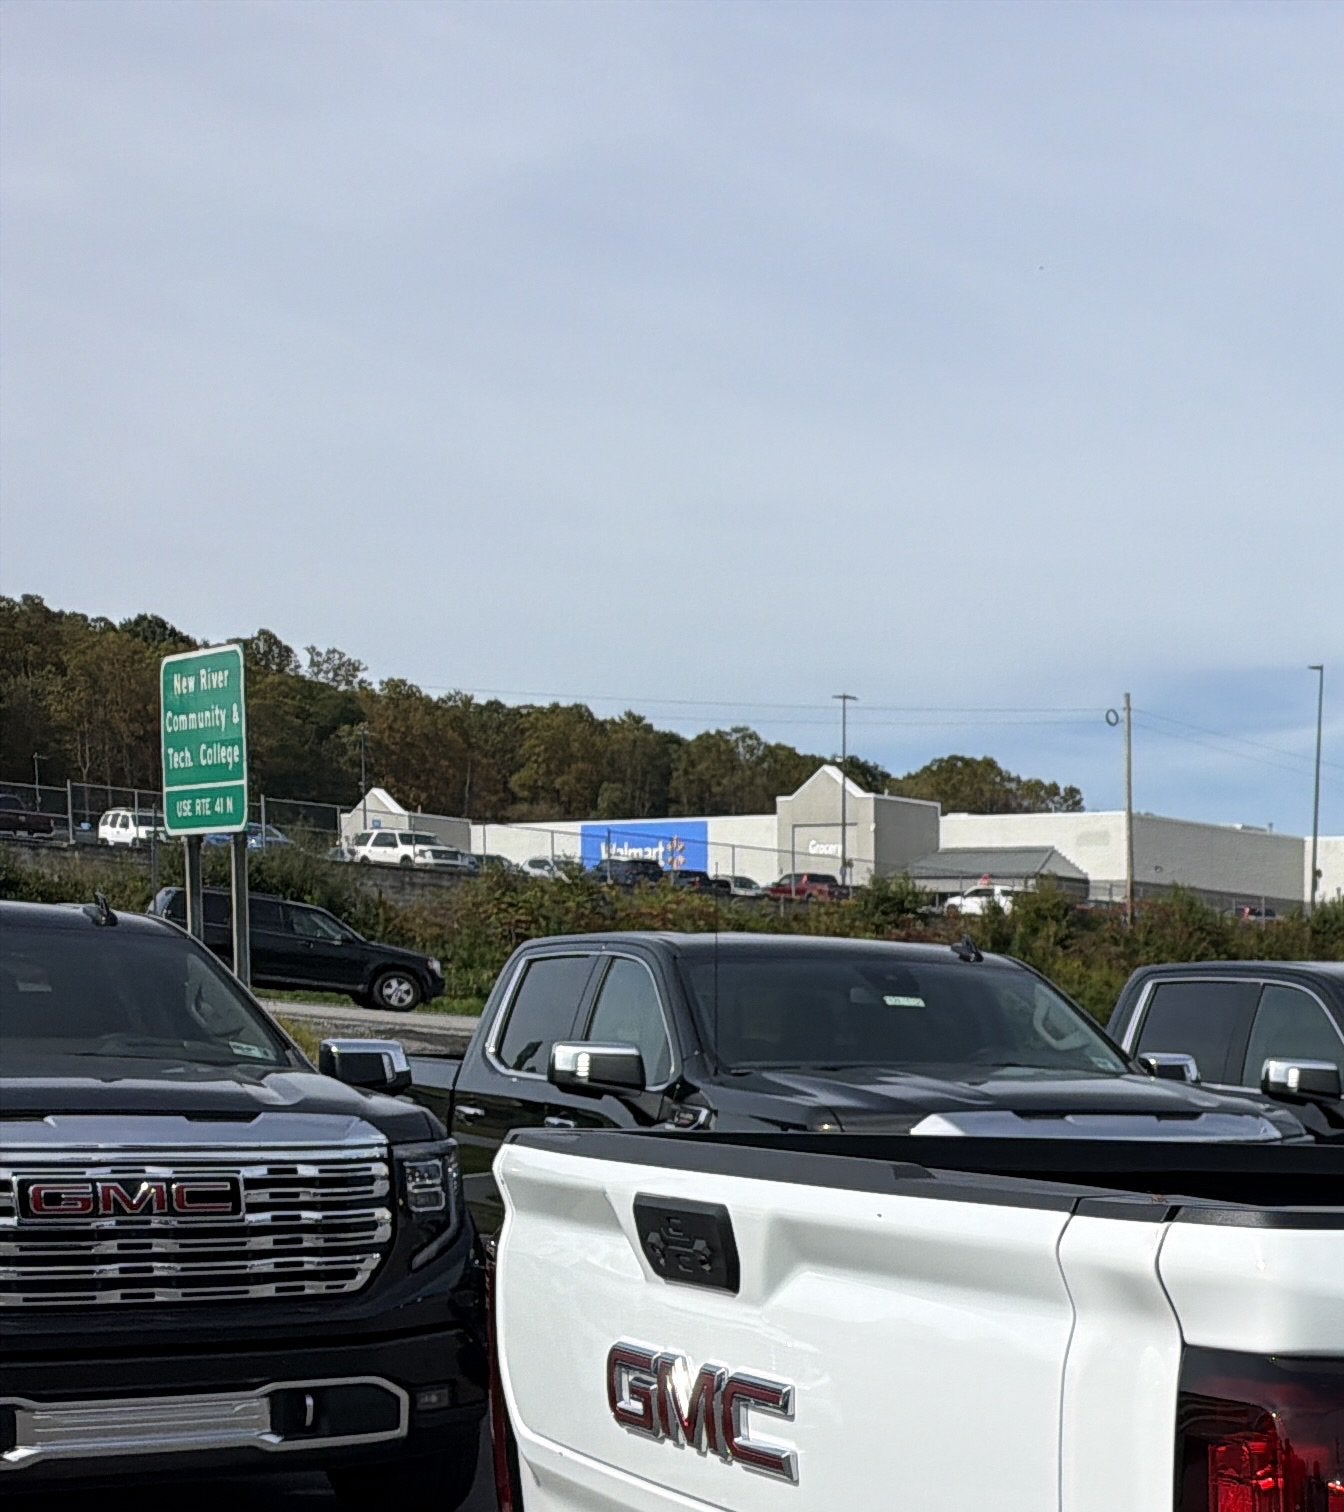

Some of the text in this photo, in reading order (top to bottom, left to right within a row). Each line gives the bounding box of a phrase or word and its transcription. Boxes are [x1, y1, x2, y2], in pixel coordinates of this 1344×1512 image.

[173, 669, 229, 695] New River
[166, 703, 240, 733] Community &
[200, 742, 240, 770] College
[176, 796, 234, 818] USE RTE 41 N
[600, 840, 665, 868] Walmart
[28, 1182, 232, 1215] GMC
[606, 1341, 799, 1487] GMC
